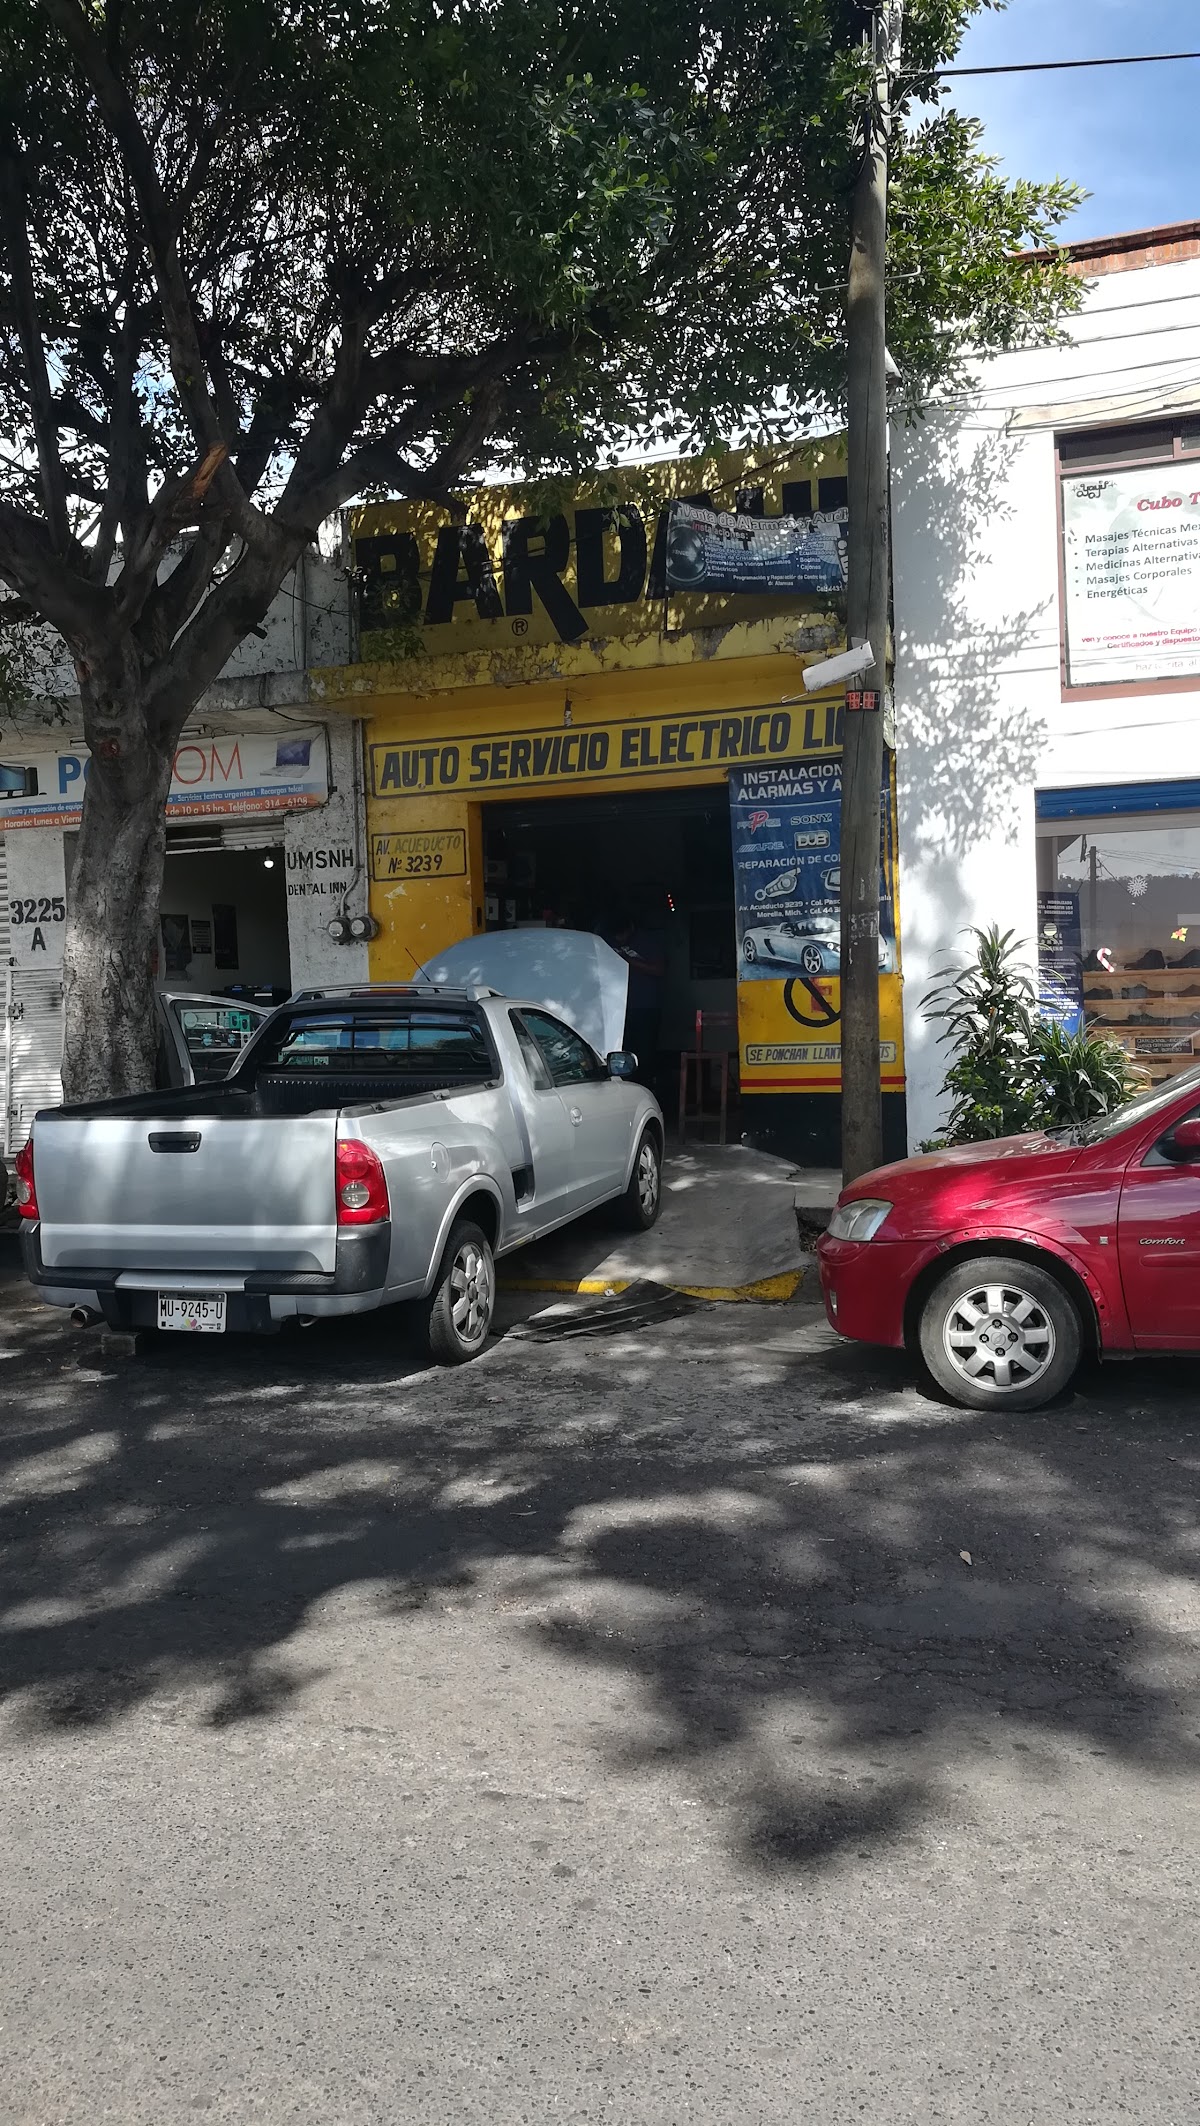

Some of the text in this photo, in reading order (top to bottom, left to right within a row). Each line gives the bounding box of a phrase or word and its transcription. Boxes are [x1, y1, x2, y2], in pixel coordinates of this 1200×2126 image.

[1137, 496, 1182, 511] Cubo
[684, 505, 717, 524] Venta
[718, 511, 736, 528] de
[1085, 532, 1129, 543] Masajes
[1132, 527, 1176, 538] Técnicas
[1085, 539, 1198, 557] Terapias Alternativas
[355, 475, 848, 641] BARD
[1086, 560, 1140, 571] Medicinas
[1086, 567, 1192, 584] Masajes Corporales
[1087, 586, 1148, 598] Energéticas
[1107, 641, 1153, 649] Certificados
[379, 746, 459, 792] AUTO
[469, 732, 610, 782] SERVICIO
[620, 711, 790, 769] ELECTRICO
[178, 794, 202, 802] Servicios
[260, 788, 287, 796] Recargas
[737, 781, 814, 802] ALARMAS
[817, 780, 828, 793] Y
[29, 805, 56, 814] reparación
[170, 808, 180, 816] de
[182, 806, 191, 815] 10
[201, 804, 210, 813] 15
[212, 803, 226, 812] hrs.
[228, 800, 263, 813] Teléfono:
[4, 819, 32, 828] Horario:
[790, 813, 833, 826] SONY
[376, 835, 460, 856] AV. ACUEDUCTO
[796, 833, 828, 847] DUB
[286, 849, 354, 870] UMSNH
[405, 854, 443, 873] 3239
[738, 856, 804, 870] REPARACIÓN
[808, 855, 822, 865] DE
[288, 882, 346, 896] DENTAL INN
[10, 896, 66, 925] 3225
[738, 904, 749, 912] Av.
[750, 902, 784, 912] Acueducto
[784, 900, 804, 909] 3239
[31, 926, 46, 952] A
[750, 1048, 763, 1062] SE
[1140, 1237, 1186, 1245] Comfort
[160, 1300, 224, 1320] MU-9245-U
